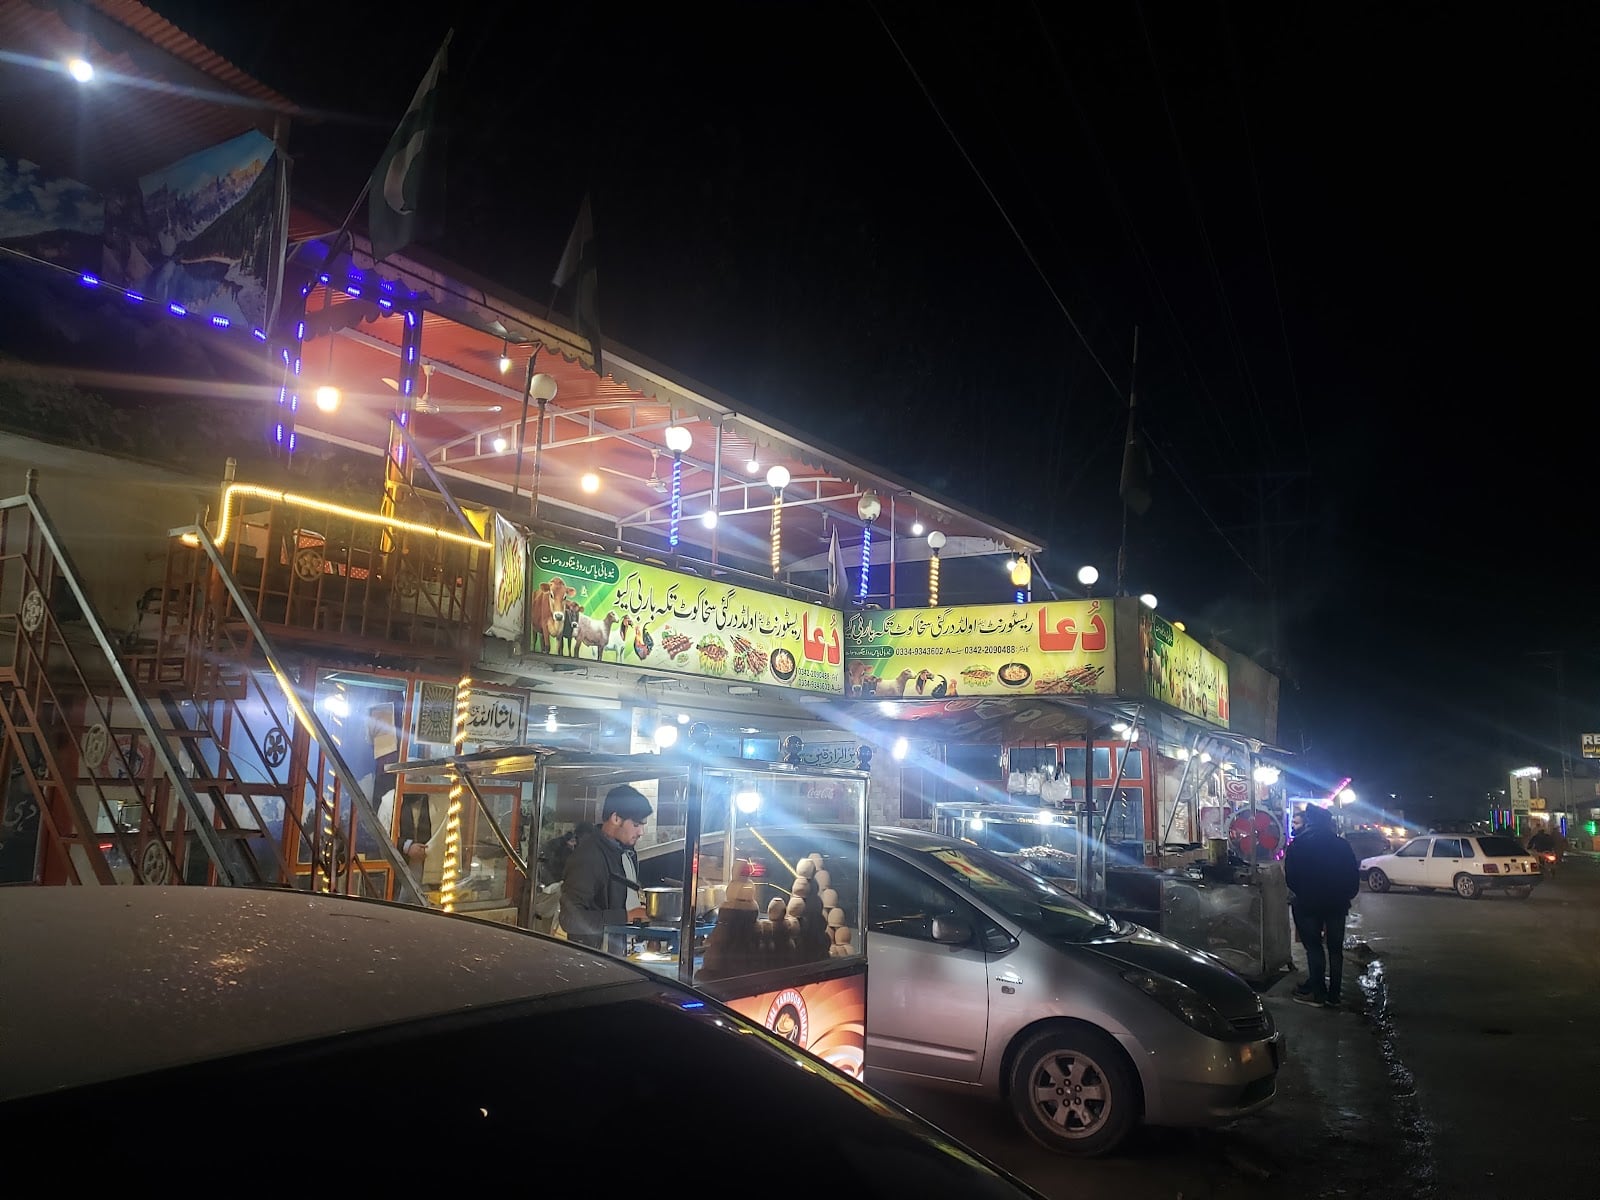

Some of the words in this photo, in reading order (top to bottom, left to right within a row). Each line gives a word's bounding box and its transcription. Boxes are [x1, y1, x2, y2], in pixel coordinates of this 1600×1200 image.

[540, 555, 559, 567] سوات
[585, 561, 598, 579] پاس
[656, 583, 679, 614] تکہ
[760, 607, 801, 641] ریسٹورنٹ
[873, 613, 896, 637] تکہ
[980, 609, 1033, 634] ریسٹورنٹ
[895, 647, 943, 656] 0334-9343602
[964, 645, 1015, 654] 0342-2090488
